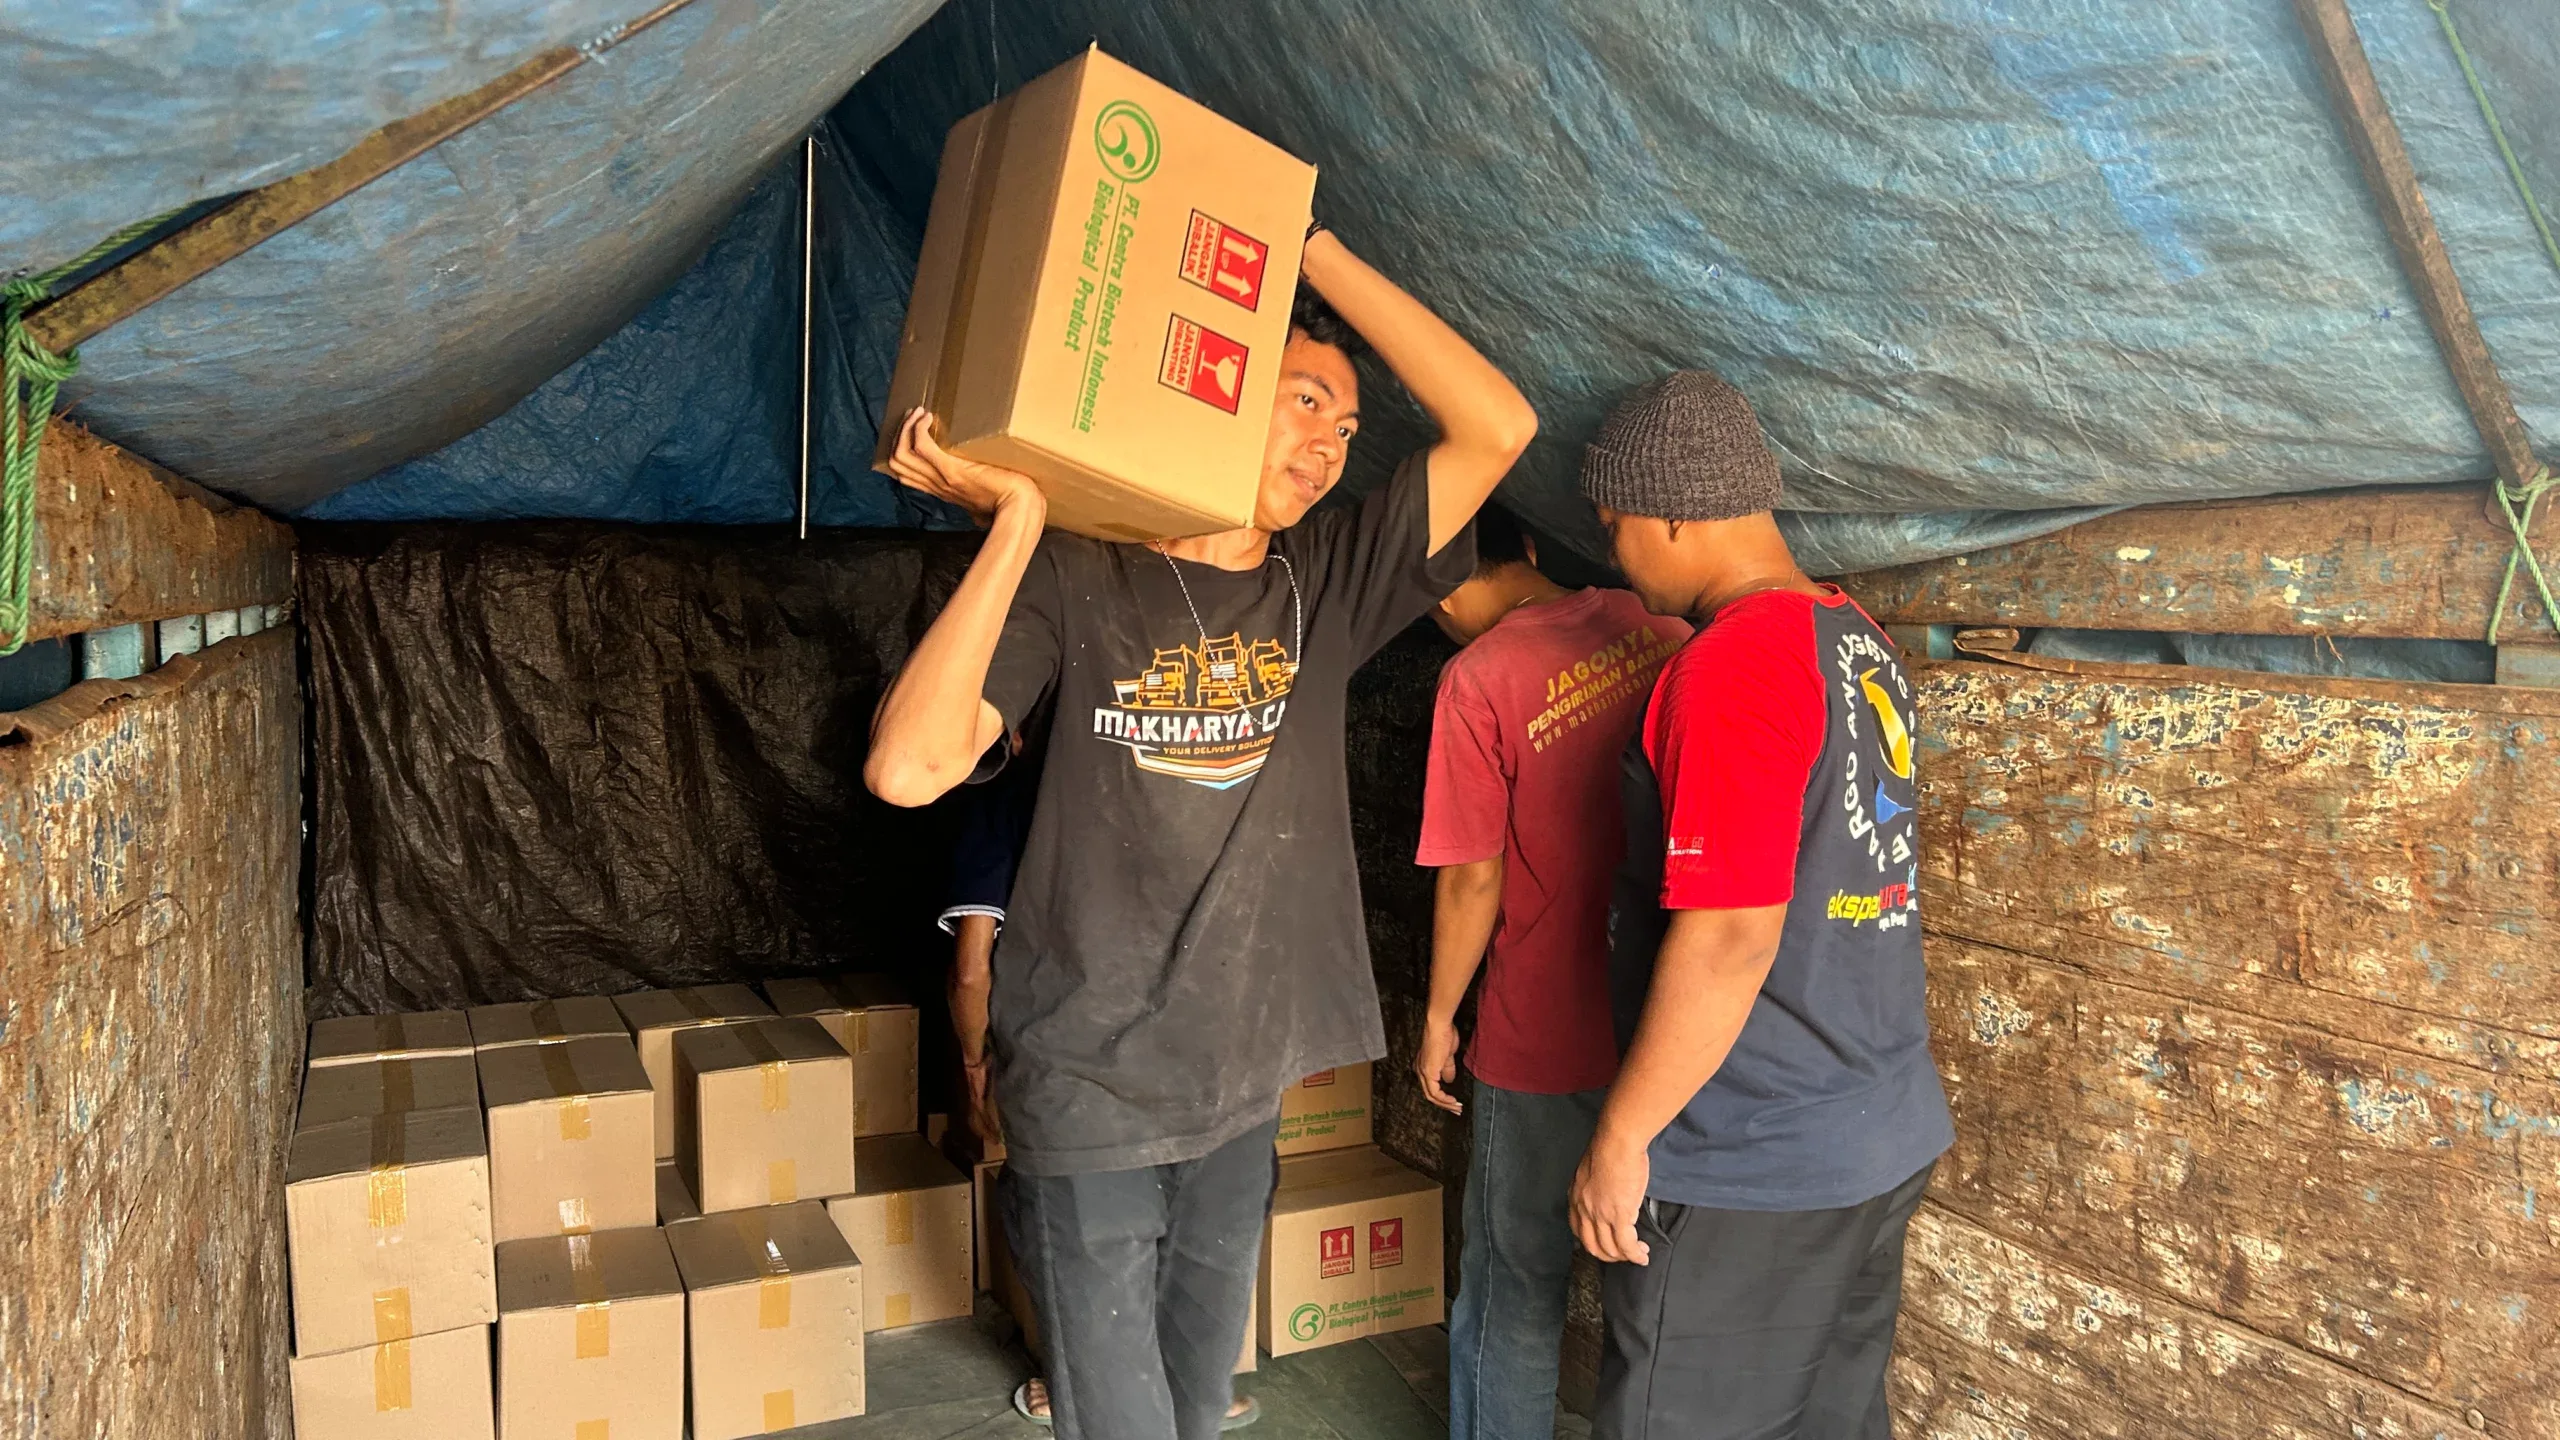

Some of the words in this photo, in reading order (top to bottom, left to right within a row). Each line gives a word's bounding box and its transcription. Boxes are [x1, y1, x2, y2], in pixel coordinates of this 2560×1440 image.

[1081, 178, 1115, 272] Biological
[1121, 192, 1140, 220] PT.
[1110, 222, 1134, 280] Centra
[1184, 215, 1204, 275] DIBALIK
[1196, 221, 1216, 281] JANGAN
[1064, 276, 1095, 352] Product
[1097, 282, 1124, 348] Biotech
[1166, 318, 1184, 381] DIBANTING
[1175, 324, 1196, 387] JANGAN
[1078, 349, 1109, 433] Indonesia
[1546, 625, 1658, 703] JAGONYA
[1093, 708, 1255, 742] MAKHARYA
[1527, 666, 1622, 740] PENGIRIMAN
[1163, 747, 1191, 756] YOUR
[1193, 744, 1236, 756] DELIVERY
